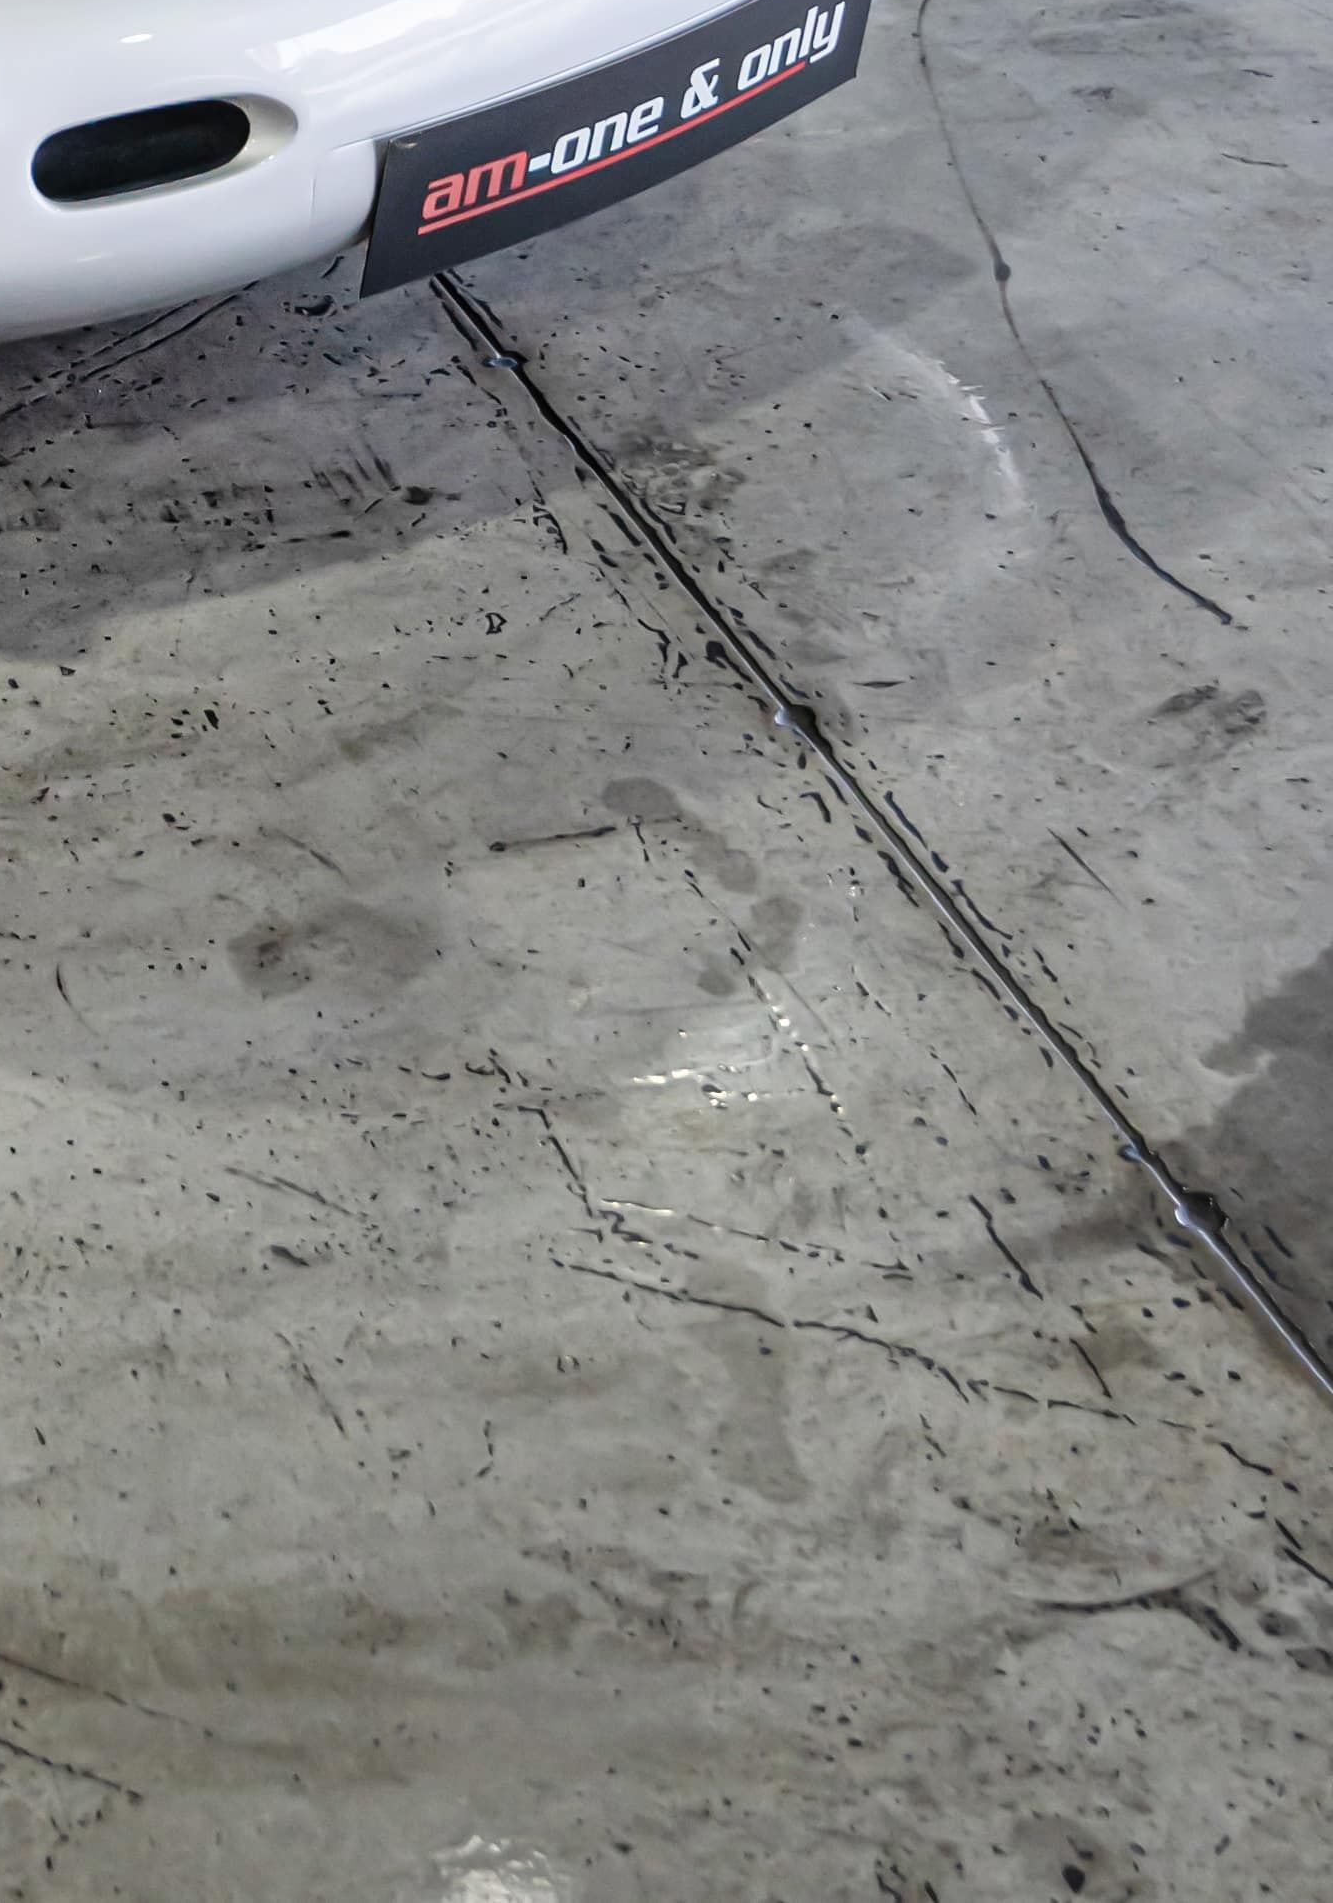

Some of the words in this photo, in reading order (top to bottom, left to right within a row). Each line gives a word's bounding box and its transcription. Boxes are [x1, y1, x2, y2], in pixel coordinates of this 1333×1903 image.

[421, 95, 664, 221] am-one
[680, 58, 721, 120] &
[736, 0, 846, 93] only
